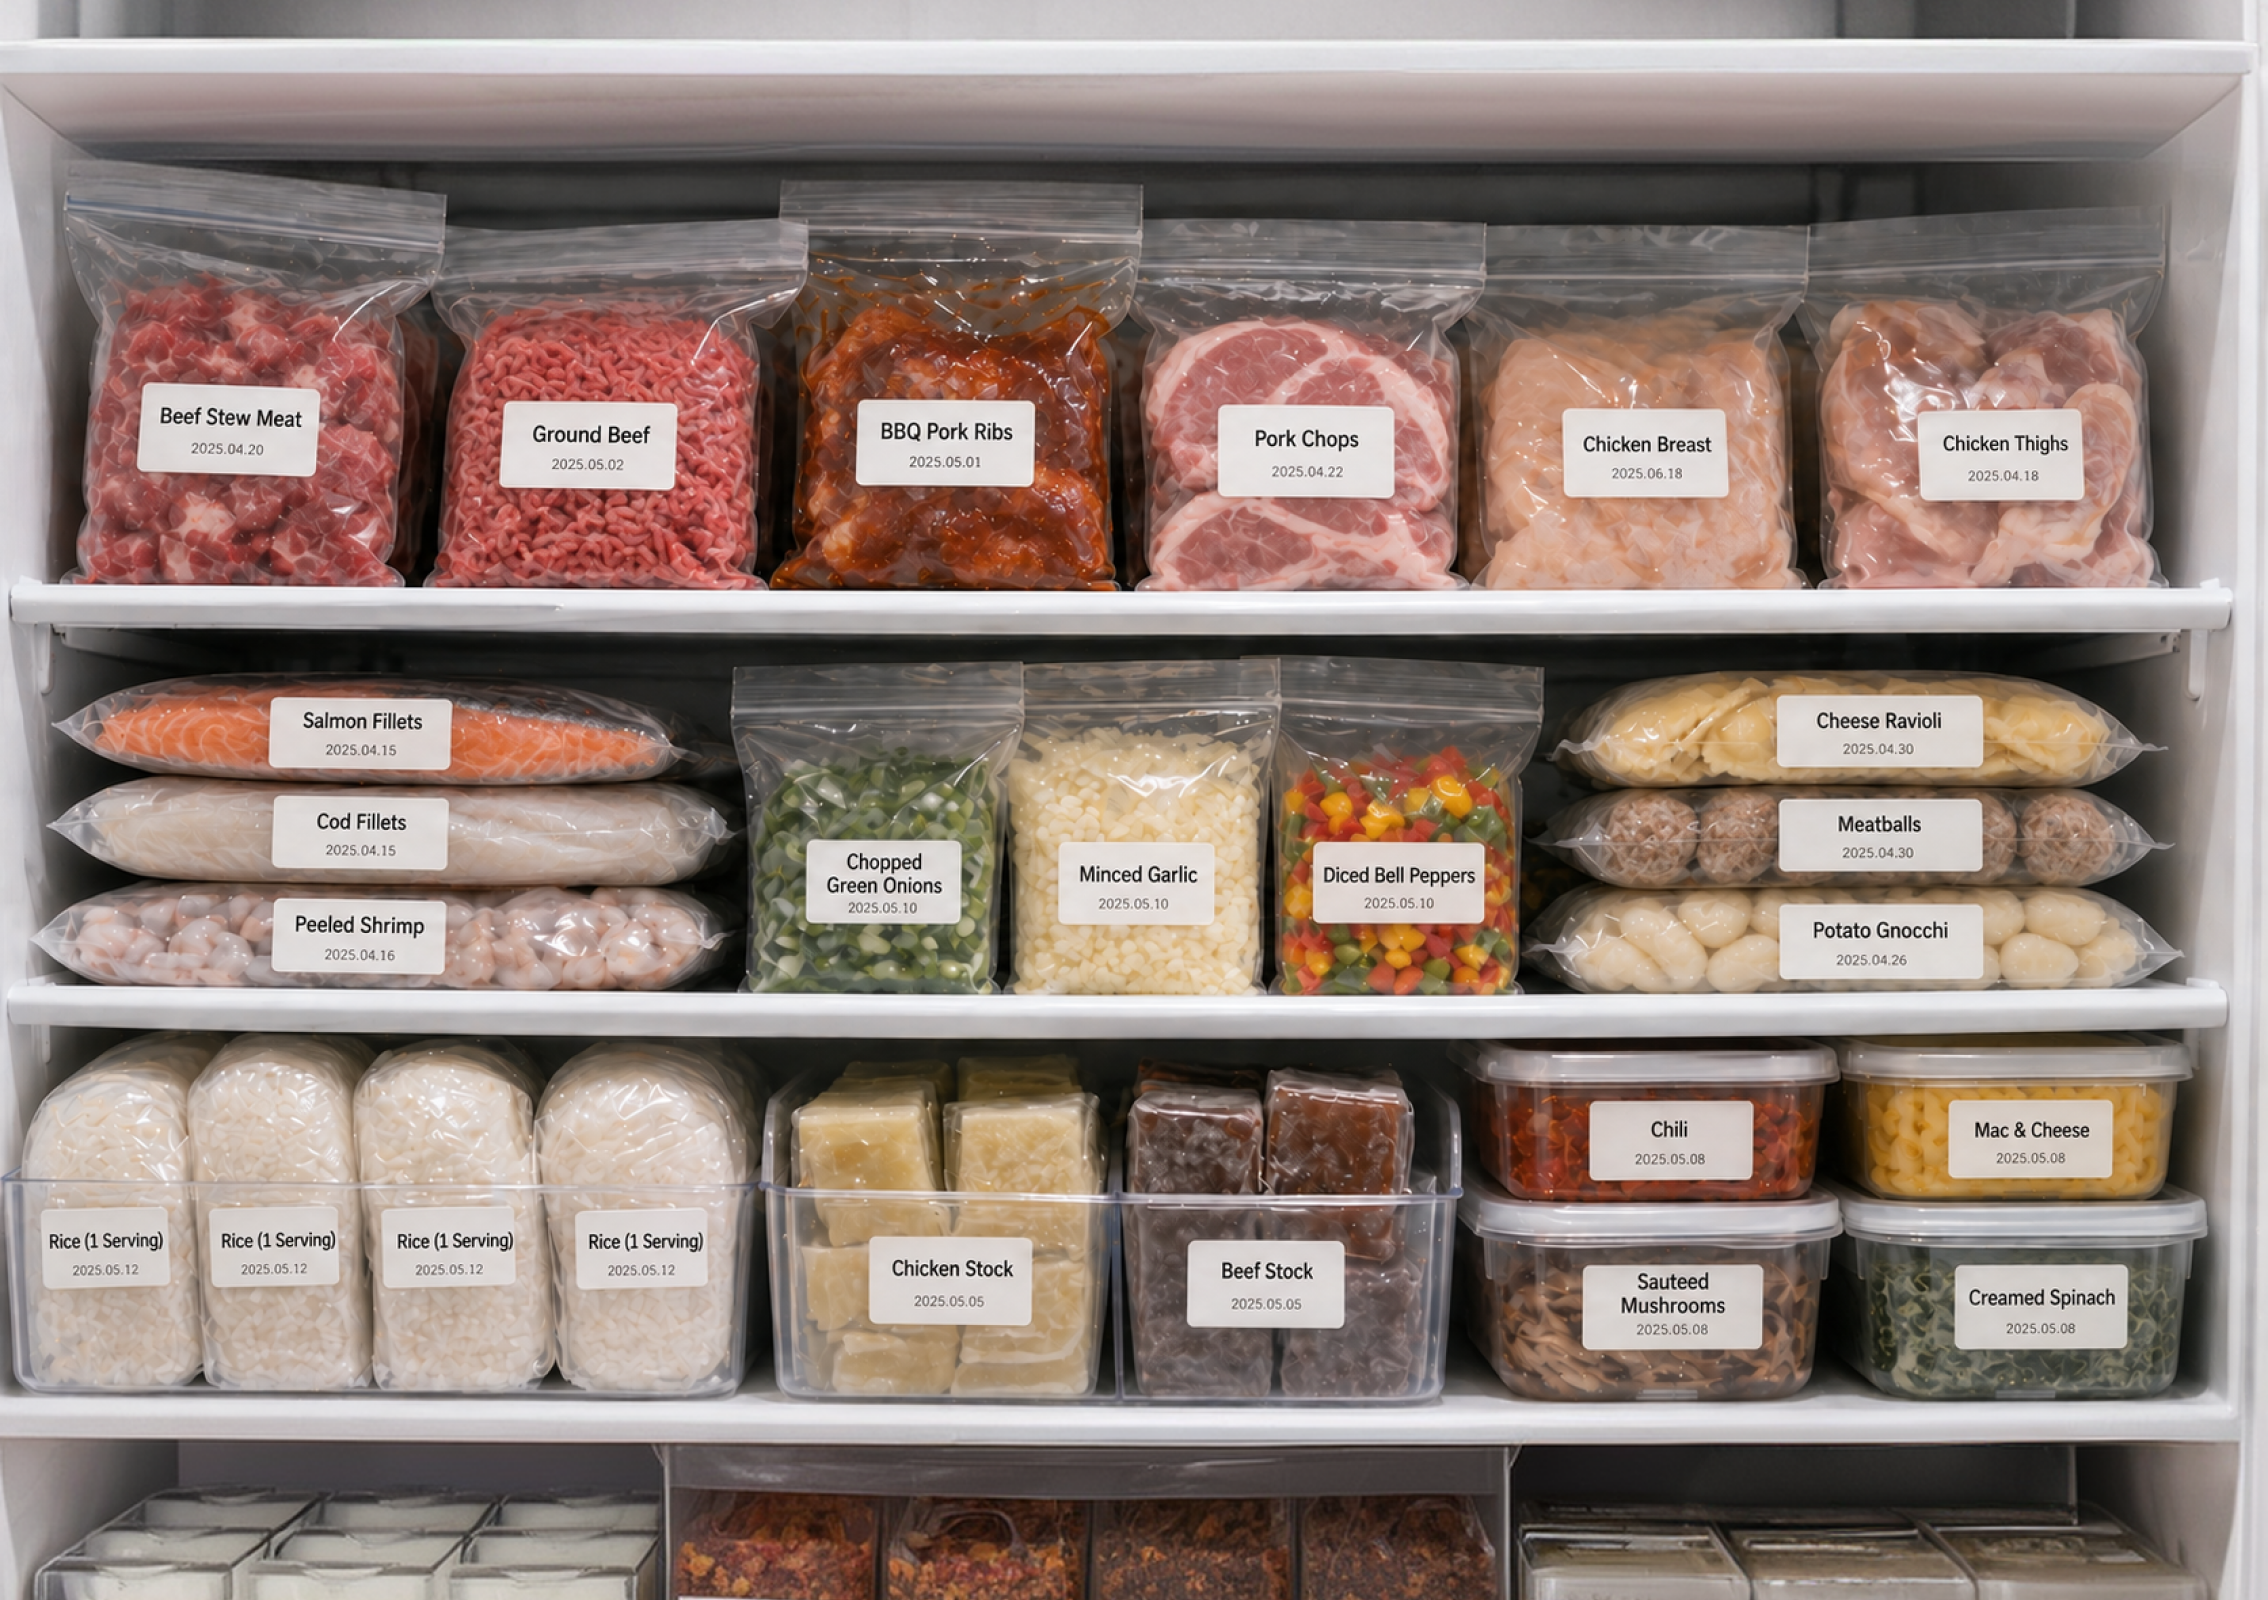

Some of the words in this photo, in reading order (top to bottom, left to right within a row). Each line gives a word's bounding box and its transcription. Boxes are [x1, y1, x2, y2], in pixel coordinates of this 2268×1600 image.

[159, 406, 203, 425] Beef
[205, 407, 252, 427] Stew
[256, 408, 303, 428] Meat
[532, 424, 602, 444] Ground
[608, 424, 652, 445] Beef
[880, 421, 922, 443] BBQ
[927, 421, 970, 441] Pork
[974, 421, 1014, 442] Ribs
[1255, 428, 1297, 448] Pork
[1301, 428, 1360, 453] Chops
[191, 442, 264, 456] 2025.04.20
[1582, 434, 1652, 453] Chicken
[1657, 435, 1713, 454] Breast
[1942, 434, 2010, 452] Chicken
[2013, 434, 2069, 456] Thighs
[551, 457, 624, 471] 2025.05.02
[909, 455, 981, 469] 2025.05.01
[1271, 465, 1344, 478] 2025.04.22
[1612, 467, 1683, 480] 2025.06.18
[1968, 469, 2040, 482] 2025.04.18
[302, 711, 368, 730] Salmon
[372, 712, 423, 731] Fillets
[1816, 711, 1881, 730] Cheese
[1885, 711, 1942, 730] Ravioli
[325, 743, 397, 756] 2025.04.15
[1842, 742, 1915, 755] 2025.04.30
[316, 811, 351, 831] Cod
[356, 812, 407, 831] Fillets
[1838, 814, 1922, 833] Meatballs
[325, 844, 397, 857] 2025.04.15
[1842, 846, 1915, 859] 2025.04.30
[846, 852, 922, 876] Chopped
[1079, 864, 1143, 884] Minced
[1147, 864, 1199, 884] Garlic
[1323, 865, 1370, 884] Diced
[1374, 865, 1405, 884] Bell
[1409, 866, 1476, 888] Peppers
[826, 875, 879, 895] Green
[882, 875, 943, 895] Onions
[848, 901, 918, 915] 2025.05.10
[1098, 897, 1169, 910] 2025.05.10
[1364, 897, 1435, 910] 2025.05.10
[295, 914, 355, 934] Peeled
[360, 915, 426, 940] Shrimp
[1813, 921, 1872, 940] Potato
[1875, 920, 1949, 940] Gnocchi
[324, 948, 396, 961] 2025.04.16
[1836, 954, 1908, 966] 2025.04.26
[1650, 1119, 1688, 1139] Chili
[1974, 1121, 2010, 1139] Mac
[2013, 1120, 2027, 1139] &
[2031, 1120, 2090, 1139] Cheese
[1635, 1153, 1706, 1166] 2025.05.08
[1996, 1152, 2066, 1164] 2025.05.08
[49, 1233, 81, 1250] Rice
[84, 1232, 99, 1252] (1
[102, 1231, 164, 1252] Serving)
[221, 1232, 254, 1249] Rice
[257, 1231, 272, 1251] (1
[275, 1230, 336, 1252] Serving)
[397, 1233, 430, 1250] Rice
[433, 1232, 449, 1252] (1
[452, 1231, 514, 1253] Serving)
[588, 1233, 621, 1250] Rice
[624, 1232, 638, 1252] (1
[642, 1231, 704, 1253] Serving)
[72, 1263, 139, 1277] 2025.05.12
[241, 1263, 308, 1276] 2025.05.12
[415, 1263, 484, 1276] 2025.05.12
[607, 1264, 675, 1277] 2025.05.12
[891, 1258, 960, 1278] Chicken
[965, 1259, 1014, 1278] Stock
[1221, 1260, 1262, 1280] Beef
[1264, 1261, 1314, 1280] Stock
[1637, 1272, 1709, 1291] Sauteed
[914, 1294, 985, 1308] 2025.05.05
[1231, 1297, 1302, 1311] 2025.05.05
[1620, 1296, 1726, 1314] Mushrooms
[1968, 1288, 2045, 1307] Creamed
[2049, 1287, 2116, 1311] Spinach
[1636, 1323, 1709, 1336] 2025.05.08
[2006, 1322, 2076, 1335] 2025.05.08
